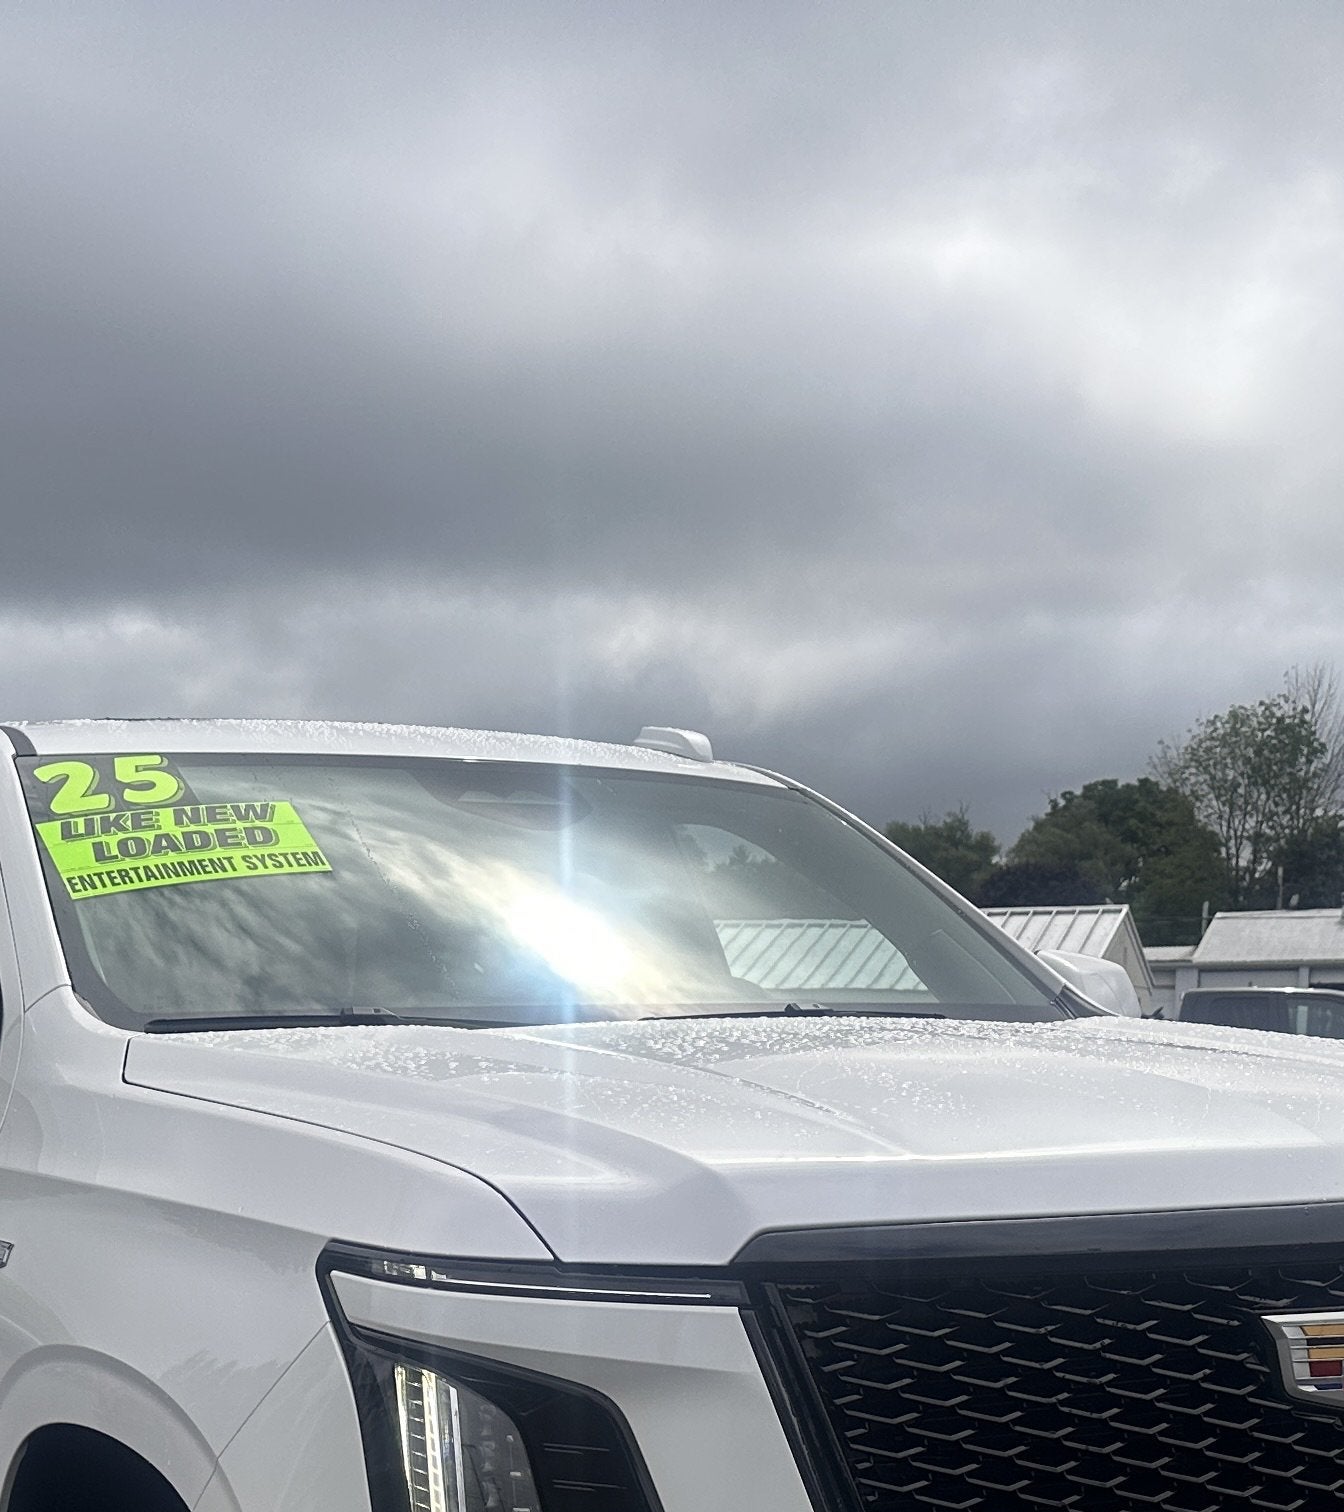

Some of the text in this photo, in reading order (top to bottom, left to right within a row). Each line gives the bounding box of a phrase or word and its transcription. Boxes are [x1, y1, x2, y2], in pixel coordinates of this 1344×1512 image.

[34, 754, 185, 815] 25
[60, 803, 275, 841] LIKE NEW
[92, 826, 280, 864] LOADED
[66, 851, 327, 893] ENTERTAINMENT SYSTEM
